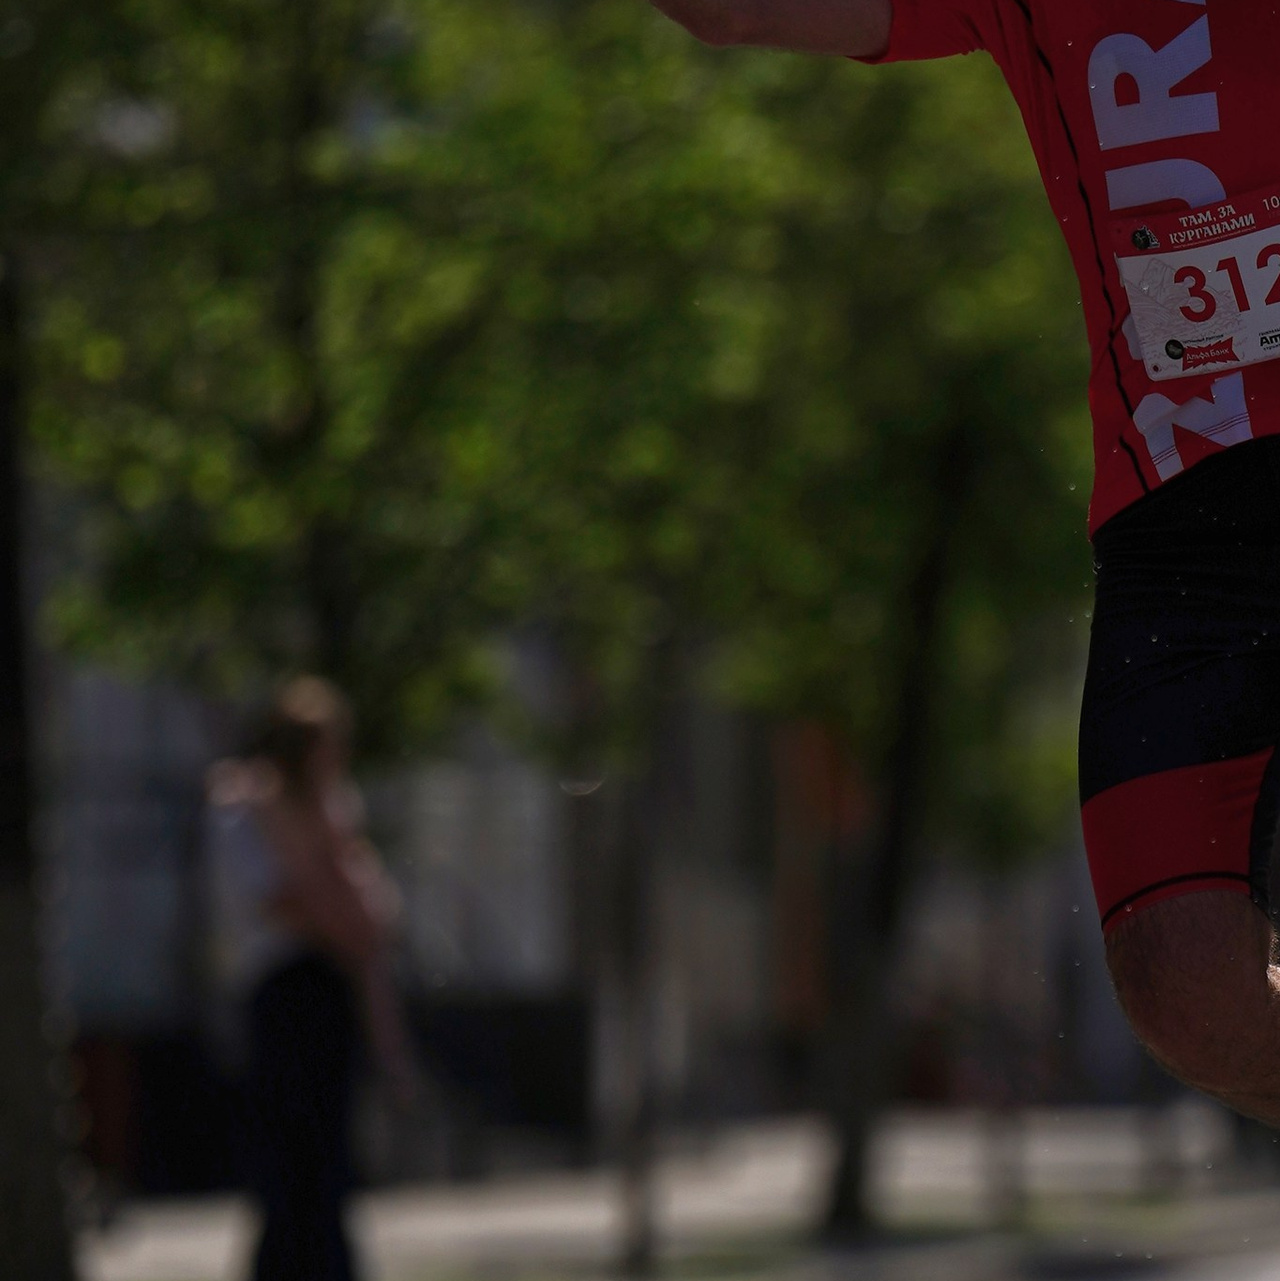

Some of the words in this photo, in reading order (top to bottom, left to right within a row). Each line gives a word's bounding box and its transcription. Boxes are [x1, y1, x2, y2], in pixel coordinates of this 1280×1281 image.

[1169, 212, 1256, 245] КУРГАНАМИ
[1178, 209, 1217, 228] ТАМ,
[1218, 204, 1237, 218] ЗА
